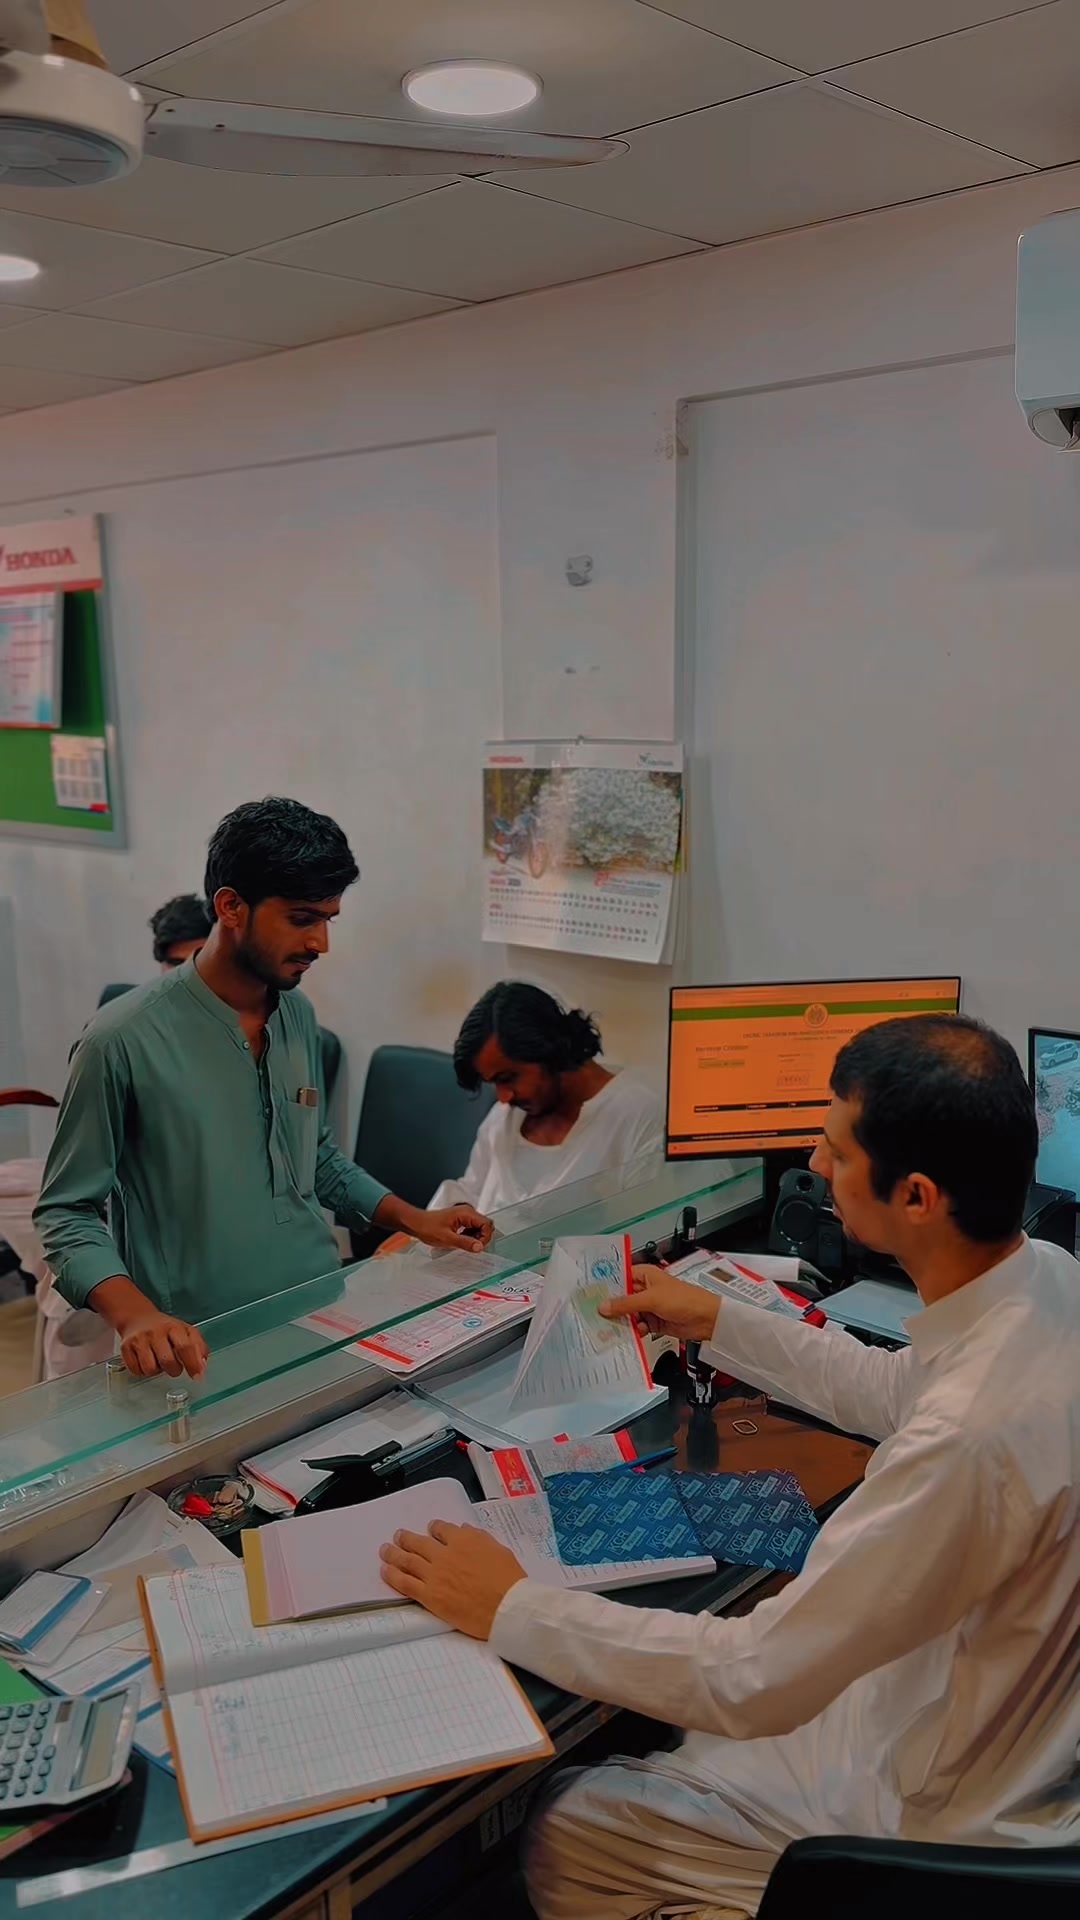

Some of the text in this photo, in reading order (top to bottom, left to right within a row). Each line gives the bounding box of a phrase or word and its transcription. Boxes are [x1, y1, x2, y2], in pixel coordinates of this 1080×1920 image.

[6, 547, 78, 572] HONDA
[557, 1481, 575, 1502] KCR
[594, 1479, 612, 1499] KCR
[633, 1477, 651, 1497] KCR
[708, 1483, 723, 1500] KCR
[746, 1480, 761, 1498] KCR
[785, 1477, 800, 1495] KCR
[562, 1508, 580, 1528] KCR
[602, 1505, 620, 1525] KCR
[643, 1502, 660, 1522] KCR
[720, 1507, 736, 1526] KCR
[760, 1505, 776, 1524] KCR
[798, 1501, 812, 1522] KCR
[568, 1535, 587, 1558] KCR
[609, 1531, 628, 1553] KCR
[651, 1528, 669, 1550] KCR
[729, 1533, 746, 1553] KCR
[769, 1531, 787, 1554] KCR
